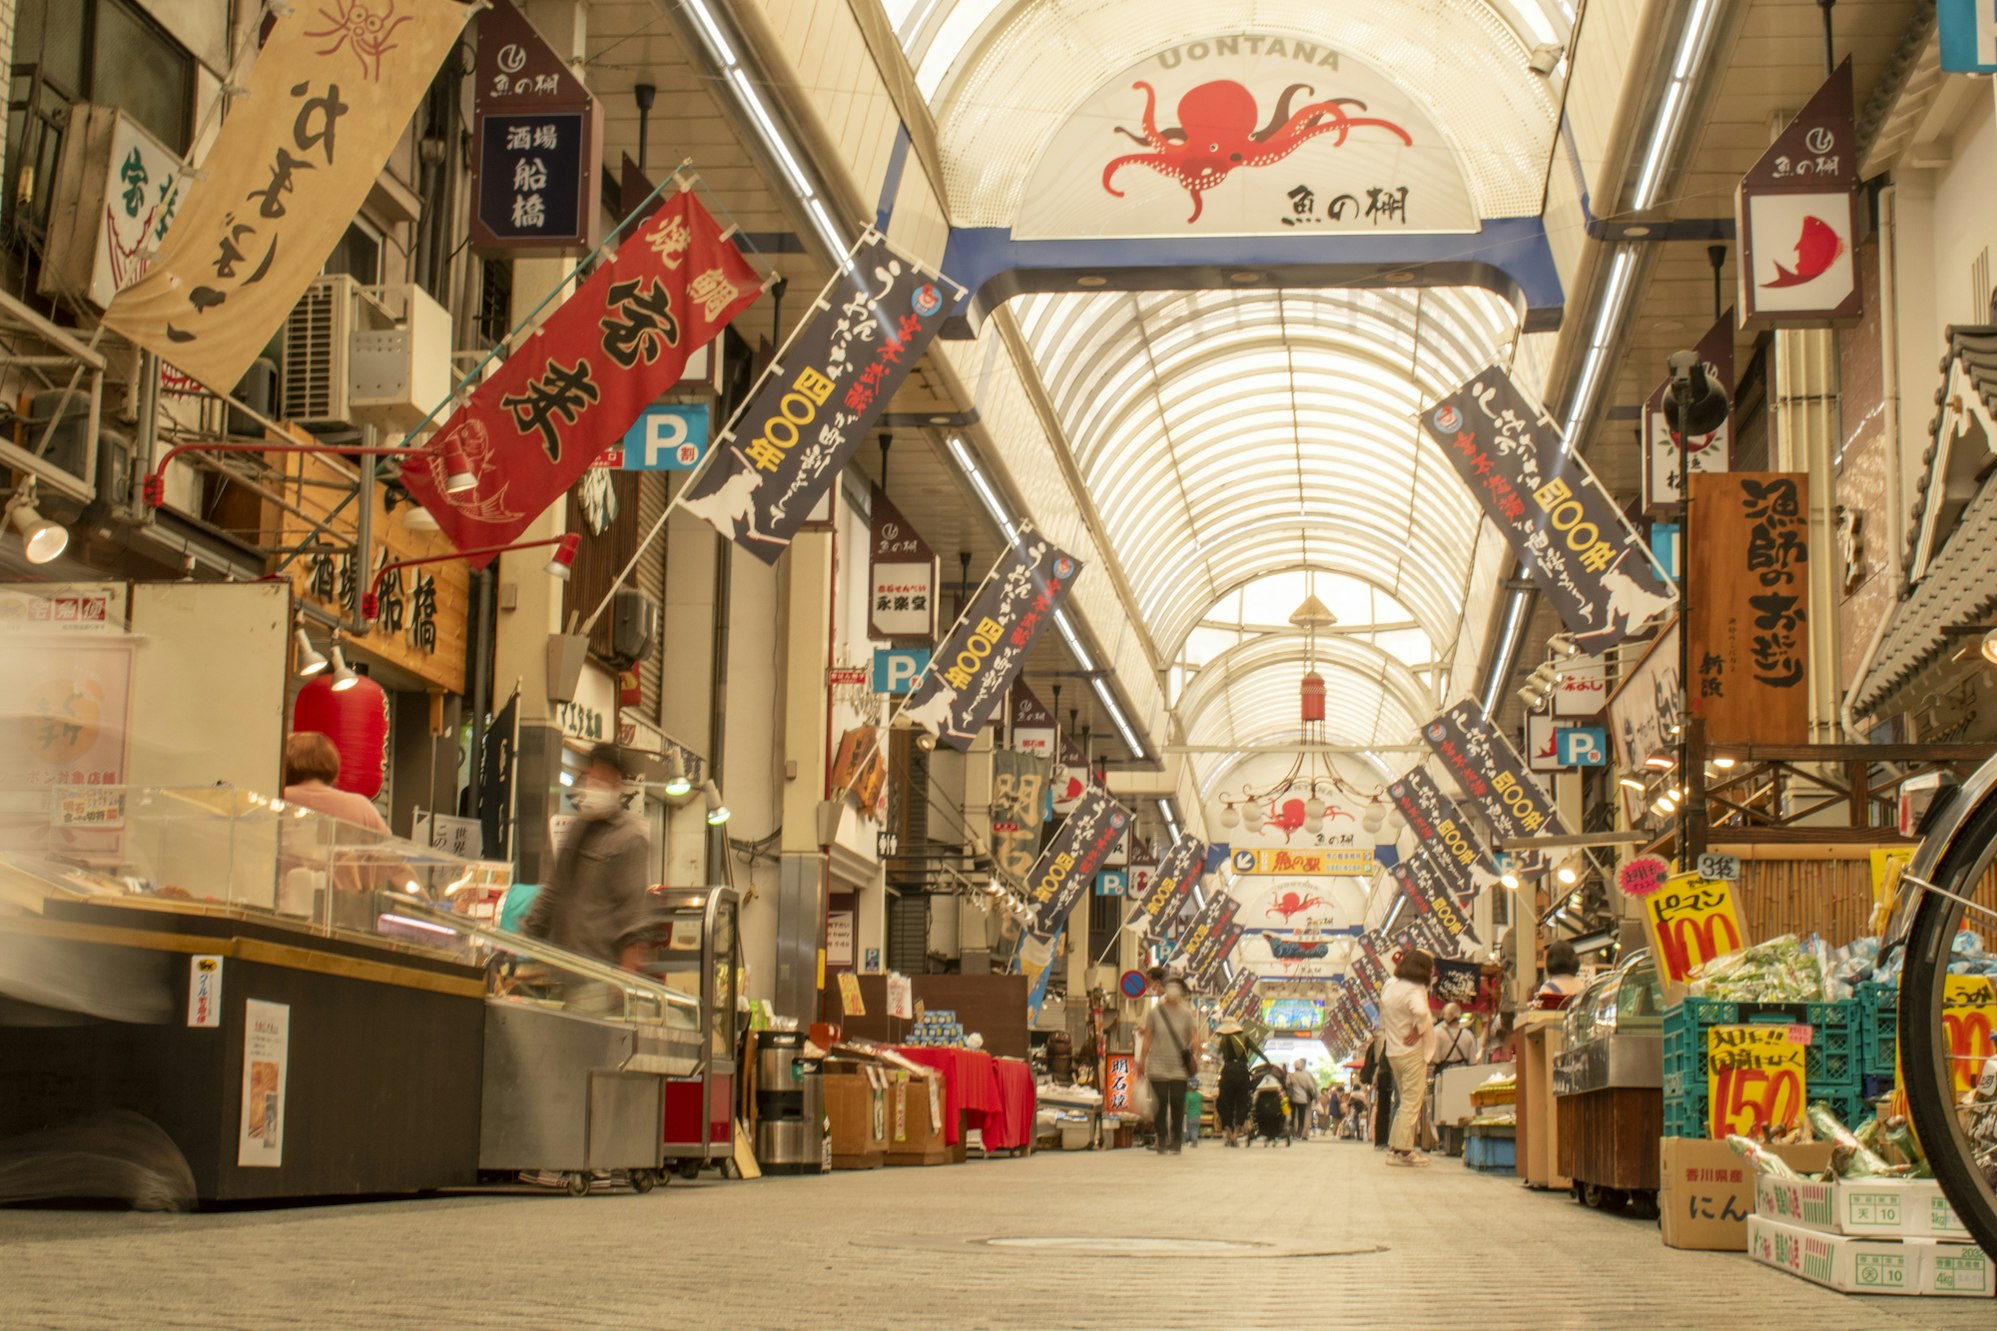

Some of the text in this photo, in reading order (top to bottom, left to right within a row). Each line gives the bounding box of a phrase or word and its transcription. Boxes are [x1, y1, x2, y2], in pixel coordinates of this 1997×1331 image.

[1158, 35, 1340, 72] UONTANA
[490, 75, 558, 97] 魚の棚
[507, 125, 557, 151] 酒場
[1772, 155, 1839, 178] 魚の棚
[511, 158, 546, 228] 船橋
[1281, 185, 1409, 226] 魚の棚
[500, 276, 681, 464] 宝来
[645, 413, 688, 466] P
[1741, 479, 1808, 688] 漁師のおにぎり
[888, 656, 915, 690] P
[1569, 733, 1594, 763] P
[1104, 876, 1118, 893] P
[1656, 913, 1740, 983] 100
[1713, 1066, 1800, 1140] 150
[1685, 1168, 1743, 1184] 香川県産
[1689, 1195, 1757, 1223] にん
[1882, 1208, 1895, 1220] 10
[1889, 1271, 1902, 1282] 10
[1936, 1272, 1953, 1287] 4kg
